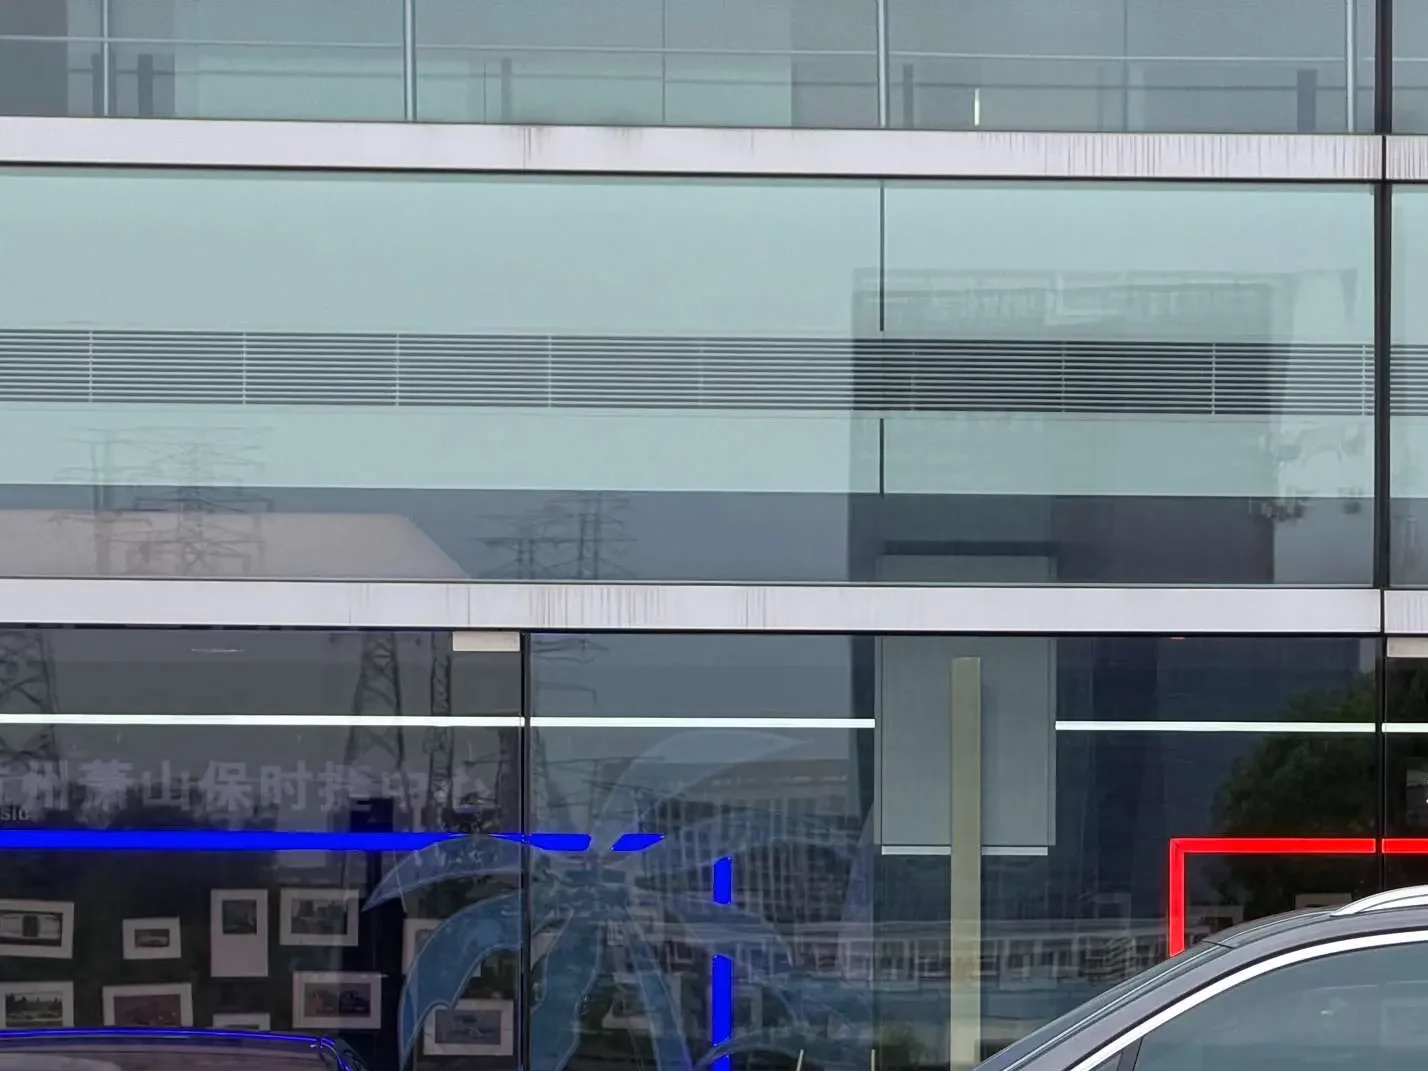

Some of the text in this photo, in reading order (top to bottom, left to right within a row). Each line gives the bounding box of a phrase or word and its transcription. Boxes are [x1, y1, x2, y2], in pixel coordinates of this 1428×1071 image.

[0, 761, 495, 815] 州萧山保时捷中心
